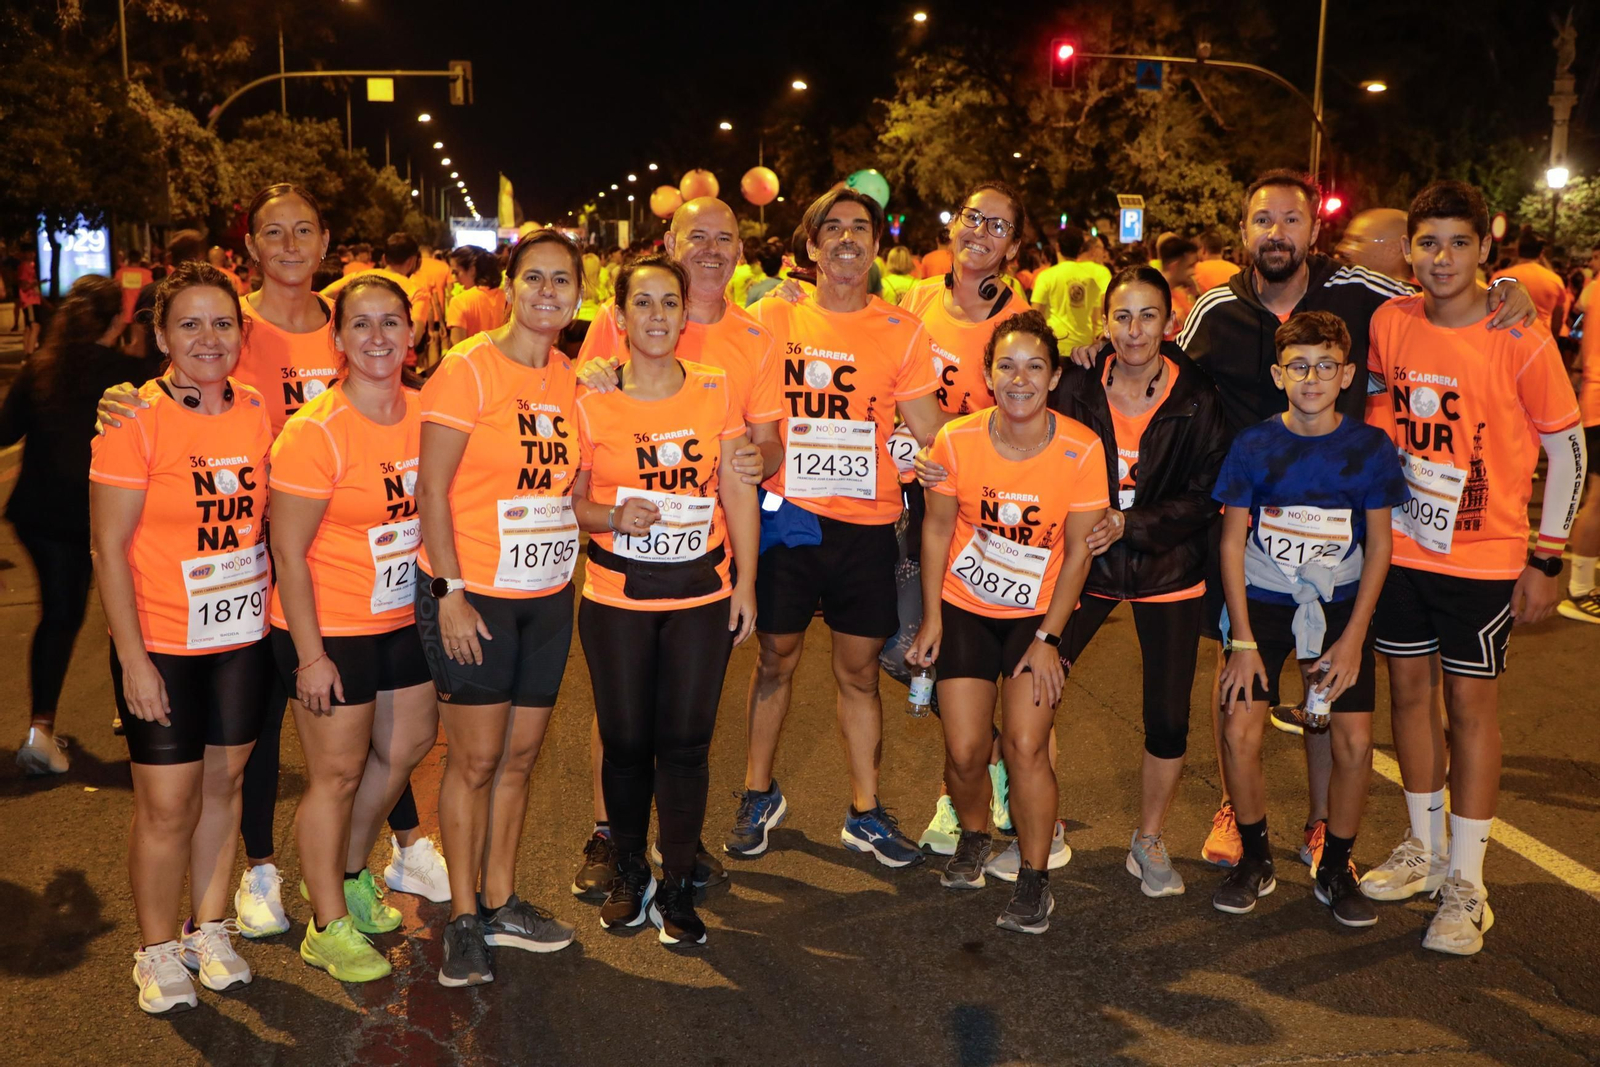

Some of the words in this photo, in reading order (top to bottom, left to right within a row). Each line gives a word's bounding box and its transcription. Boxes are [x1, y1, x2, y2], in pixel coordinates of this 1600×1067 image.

[1125, 211, 1138, 228] P
[786, 342, 802, 355] 36
[804, 346, 855, 362] CARRERA
[931, 343, 960, 364] CARRERA
[281, 366, 297, 379] 36
[1394, 366, 1406, 380] 36
[1408, 370, 1458, 387] CARRERA
[517, 399, 530, 411] 36
[530, 403, 561, 413] CARRERA
[785, 391, 851, 420] TUR
[634, 432, 649, 444] 36
[651, 428, 695, 442] CARRERA
[1396, 418, 1454, 455] TUR
[190, 456, 206, 468] 36
[207, 455, 249, 467] CARRERA
[520, 441, 569, 465] TUR
[886, 439, 916, 462] 12
[1568, 434, 1582, 479] CARRERA
[379, 461, 395, 474] 36
[793, 453, 869, 477] 12433
[517, 468, 551, 490] NA
[639, 467, 699, 491] TUR
[982, 486, 996, 498] 36
[998, 491, 1039, 503] CARRERA
[1571, 481, 1581, 501] DEL
[196, 495, 253, 523] TUR
[198, 525, 239, 551] NA
[621, 530, 702, 556] 13676
[510, 539, 576, 568] 18795
[383, 560, 417, 588] 121
[956, 556, 1031, 605] 20878
